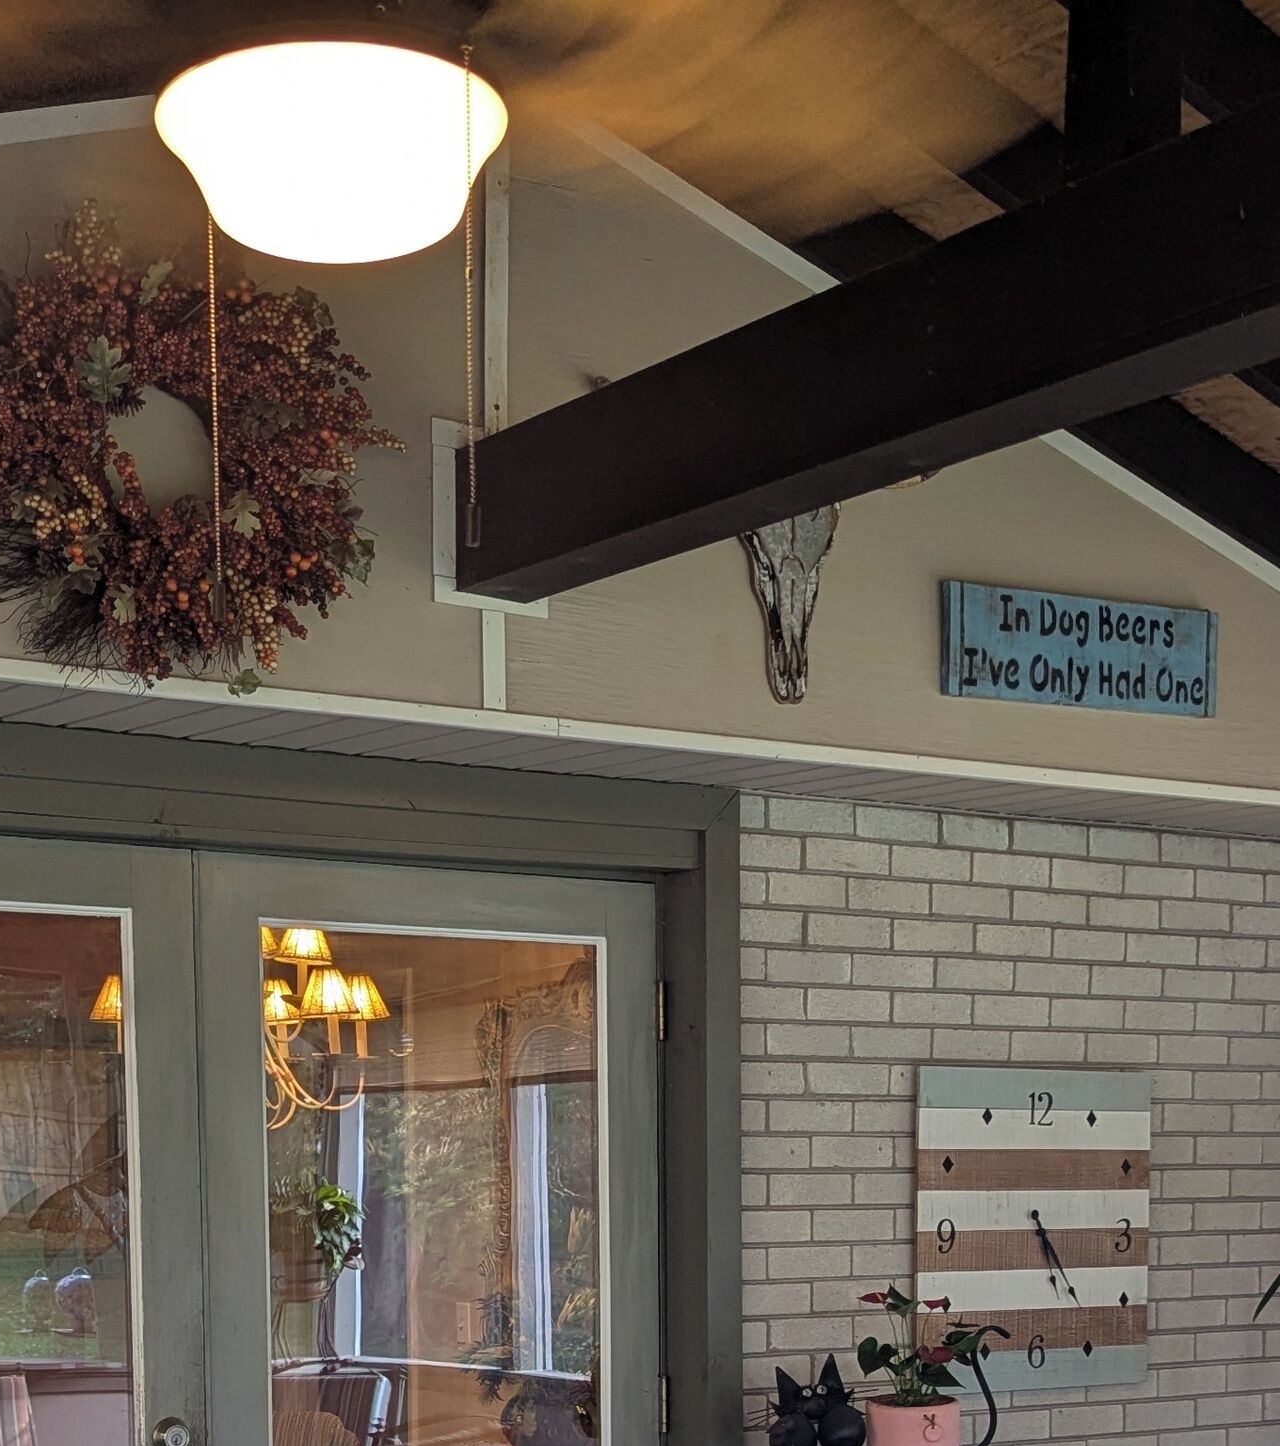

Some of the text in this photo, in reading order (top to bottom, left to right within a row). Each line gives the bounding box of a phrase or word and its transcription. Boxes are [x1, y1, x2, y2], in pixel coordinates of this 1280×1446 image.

[999, 594, 1175, 648] In Dog Beers
[963, 647, 1204, 705] I've Only Had One
[1028, 1091, 1054, 1127] 12
[936, 1218, 956, 1254] 9
[1114, 1218, 1131, 1253] 3
[1027, 1334, 1046, 1369] 6
